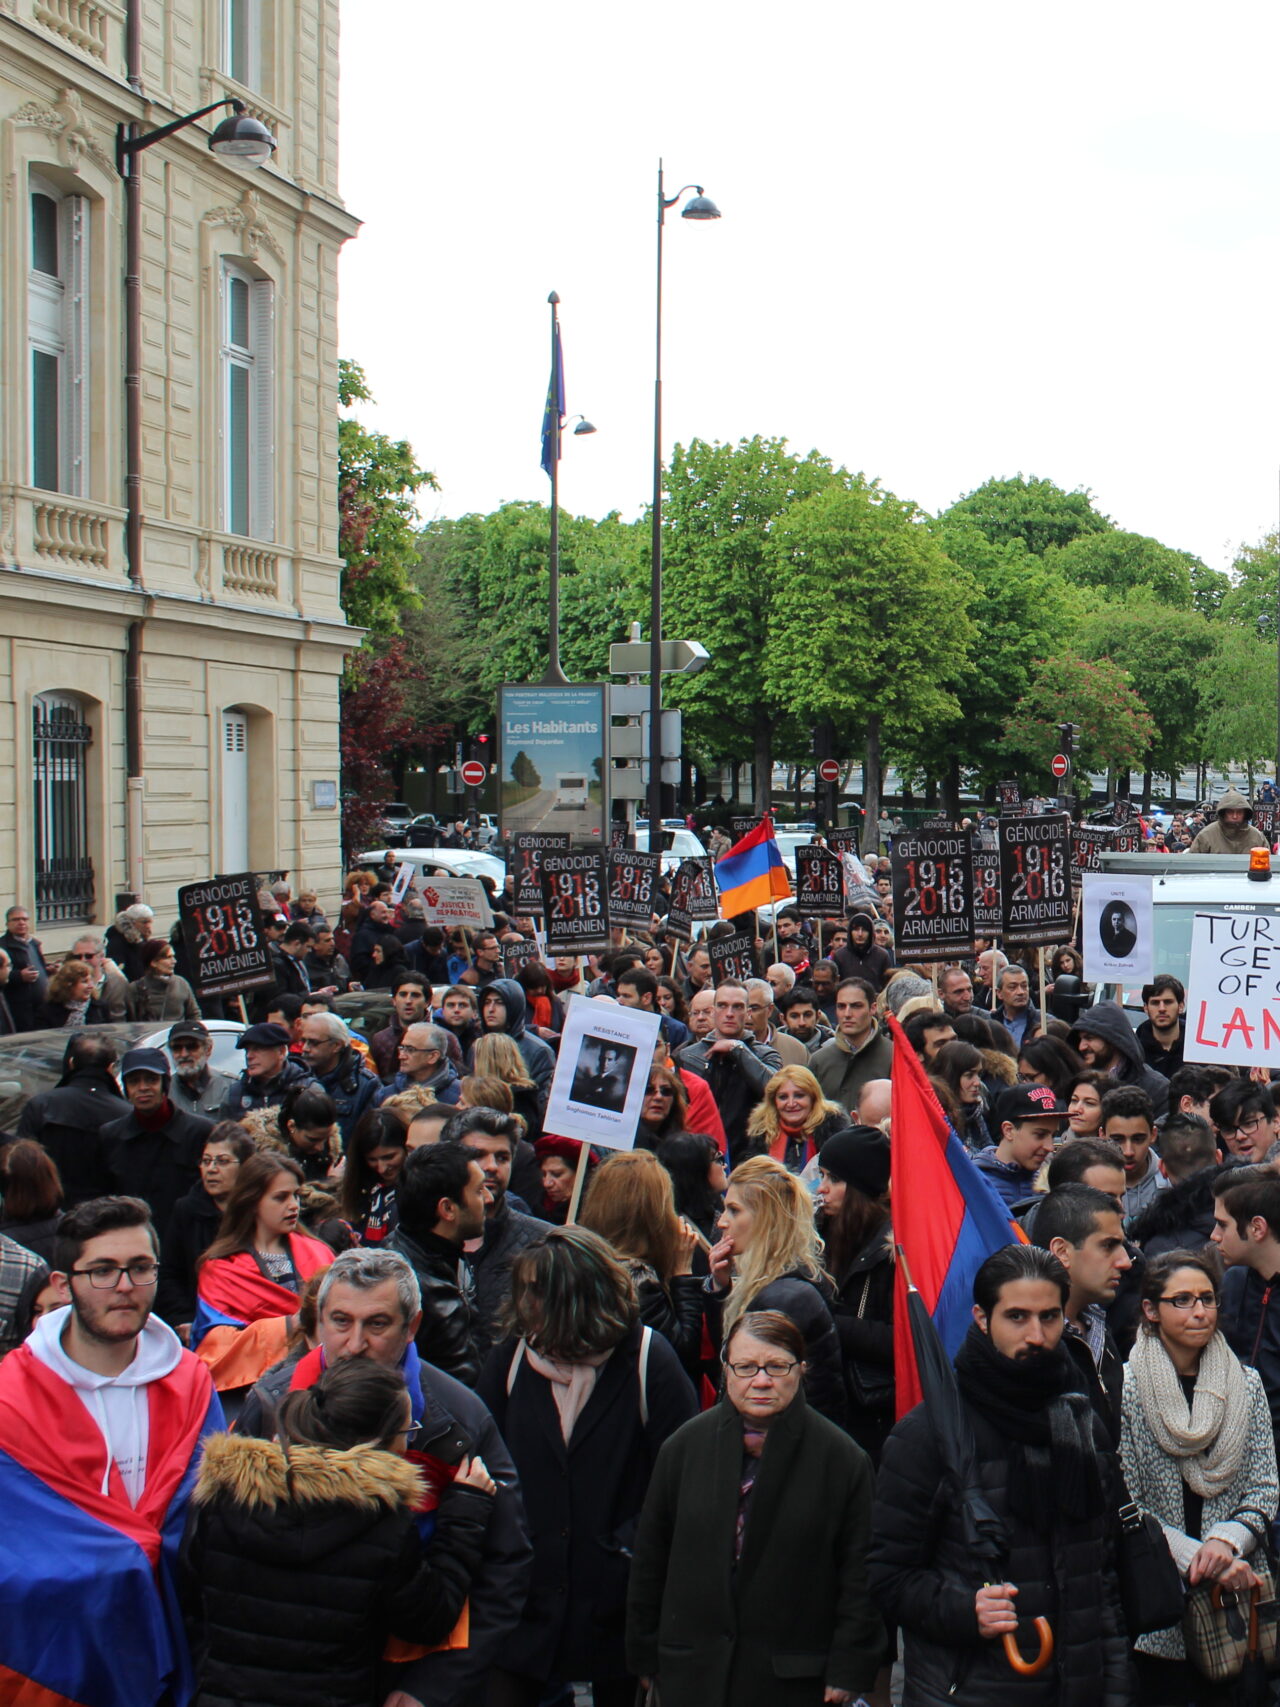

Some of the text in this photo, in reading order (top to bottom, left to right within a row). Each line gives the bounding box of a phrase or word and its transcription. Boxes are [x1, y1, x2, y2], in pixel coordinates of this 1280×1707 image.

[506, 720, 598, 734] Les Habitants
[1005, 822, 1064, 843] GÉNOCIDE
[518, 837, 567, 849] GÉNOCIDE
[898, 838, 966, 858] GÉNOCIDE
[1074, 840, 1101, 855] 1915
[543, 854, 601, 871] GÉNOCIDE
[612, 851, 657, 868] GÉNOCIDE
[802, 860, 838, 877] 1915
[1012, 843, 1064, 874] 1915
[1071, 852, 1100, 868] 2016
[614, 865, 653, 885] 1915
[802, 875, 839, 892] 2016
[904, 858, 964, 889] 1915
[183, 880, 251, 907] GÉNOCIDE
[549, 871, 599, 898] 1915
[610, 881, 651, 902] 2016
[1011, 869, 1065, 900] 2016
[550, 894, 601, 919] 2016
[608, 899, 651, 914] ARMÉNIEN
[903, 884, 965, 916] 2016
[1223, 904, 1256, 912] CAMBEN
[192, 899, 253, 935] 1915
[1009, 902, 1069, 921] ARMÉNIEN
[551, 917, 605, 935] ARMÉNIEN
[902, 916, 969, 936] ARMÉNIEN
[199, 923, 258, 959] 2016
[711, 936, 752, 959] GÉNOCIDE
[200, 950, 266, 977] ARMÉNIEN
[716, 952, 754, 980] 1915
[1218, 975, 1262, 997] OF
